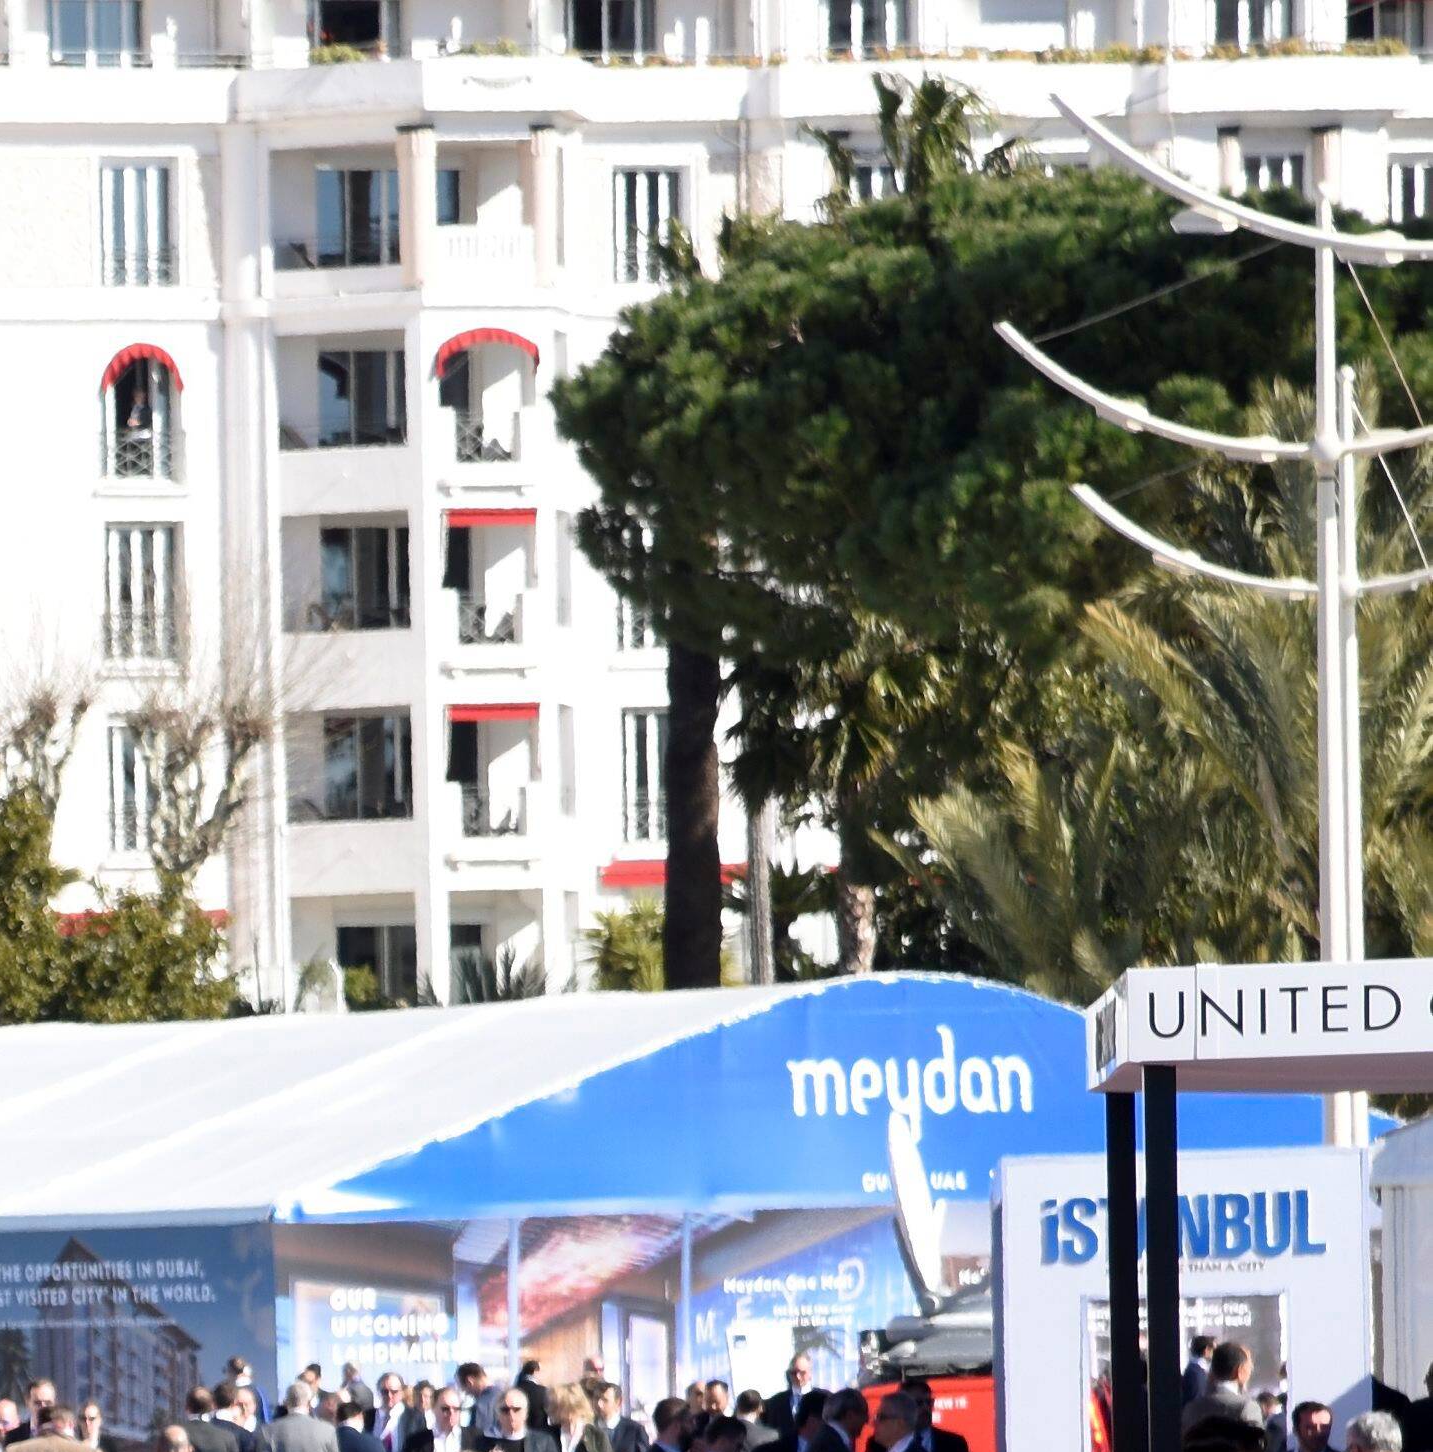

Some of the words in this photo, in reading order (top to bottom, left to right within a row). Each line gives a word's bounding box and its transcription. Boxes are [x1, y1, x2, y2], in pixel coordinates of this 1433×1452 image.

[1148, 984, 1402, 1039] UNITED
[786, 1024, 1033, 1144] meydan
[1040, 1189, 1327, 1267] iSNBUL
[24, 1260, 133, 1284] OPPORTUNITIES
[136, 1259, 153, 1280] IN
[15, 1284, 68, 1308] VISITED
[112, 1284, 128, 1305] IN
[131, 1283, 160, 1305] THE
[723, 1276, 783, 1297] Meydan
[329, 1287, 377, 1312] OUR
[330, 1313, 450, 1338] UPCOMING
